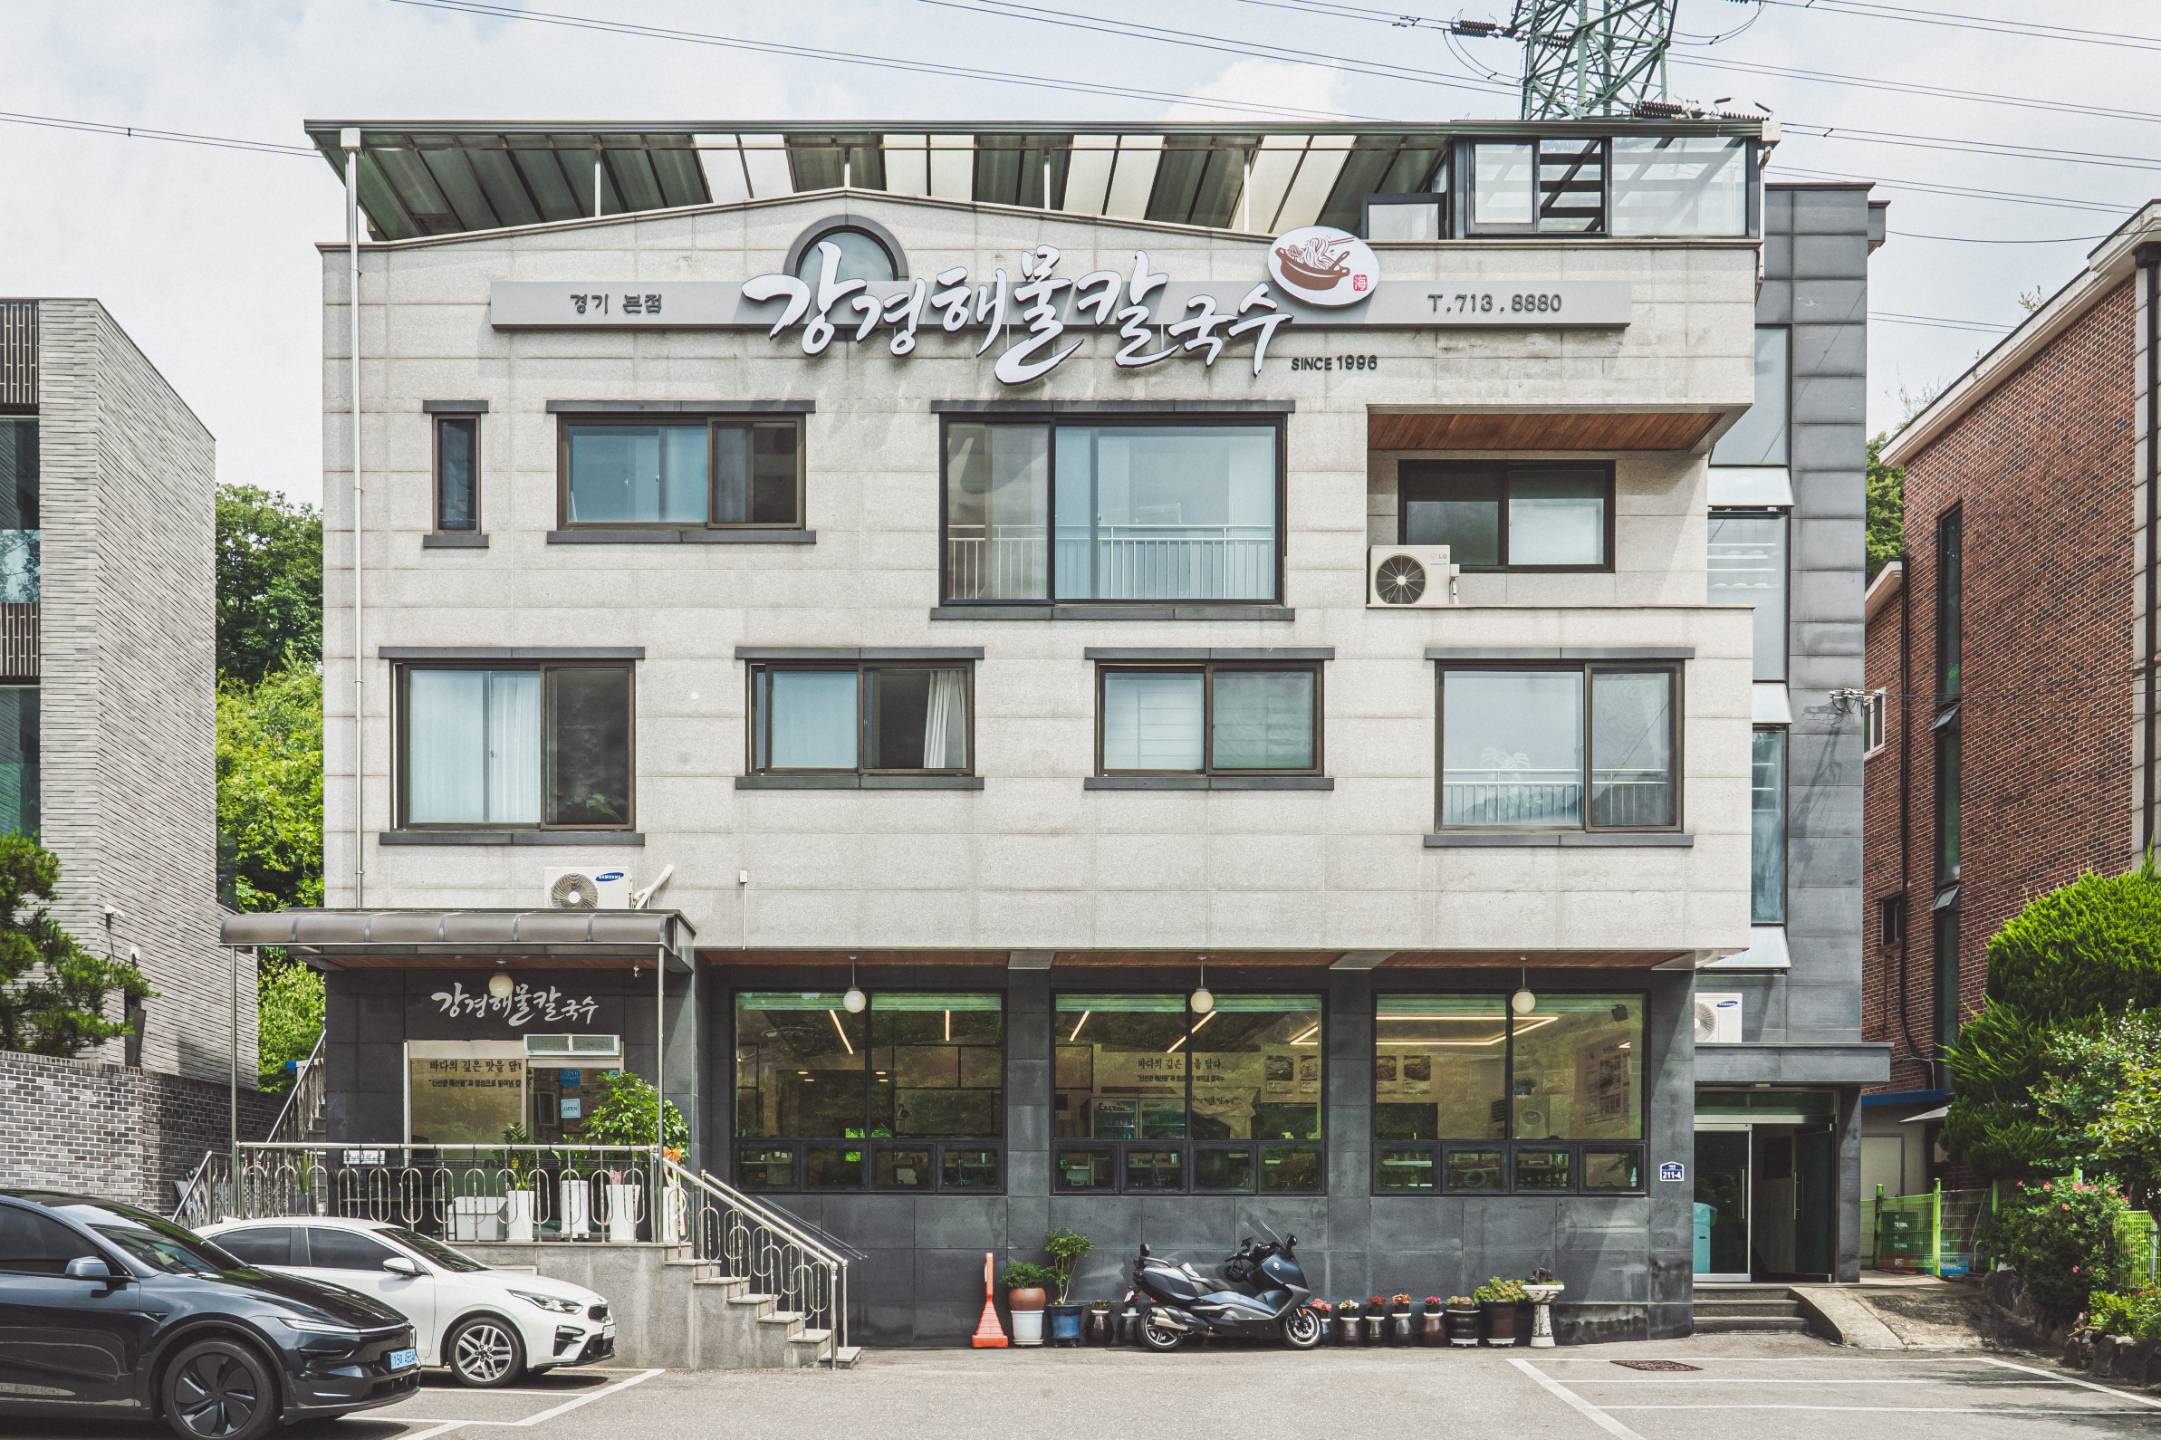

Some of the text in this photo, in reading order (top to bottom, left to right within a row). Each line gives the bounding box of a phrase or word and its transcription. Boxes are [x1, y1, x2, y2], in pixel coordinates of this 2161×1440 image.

[569, 293, 663, 315] 경기 본점
[741, 241, 1296, 386] 강경해물칼국수
[1290, 354, 1378, 371] SINCE 1996
[431, 982, 600, 1027] 강경해물칼국수
[430, 1060, 457, 1072] 바다의
[1662, 1171, 1682, 1179] 211-4
